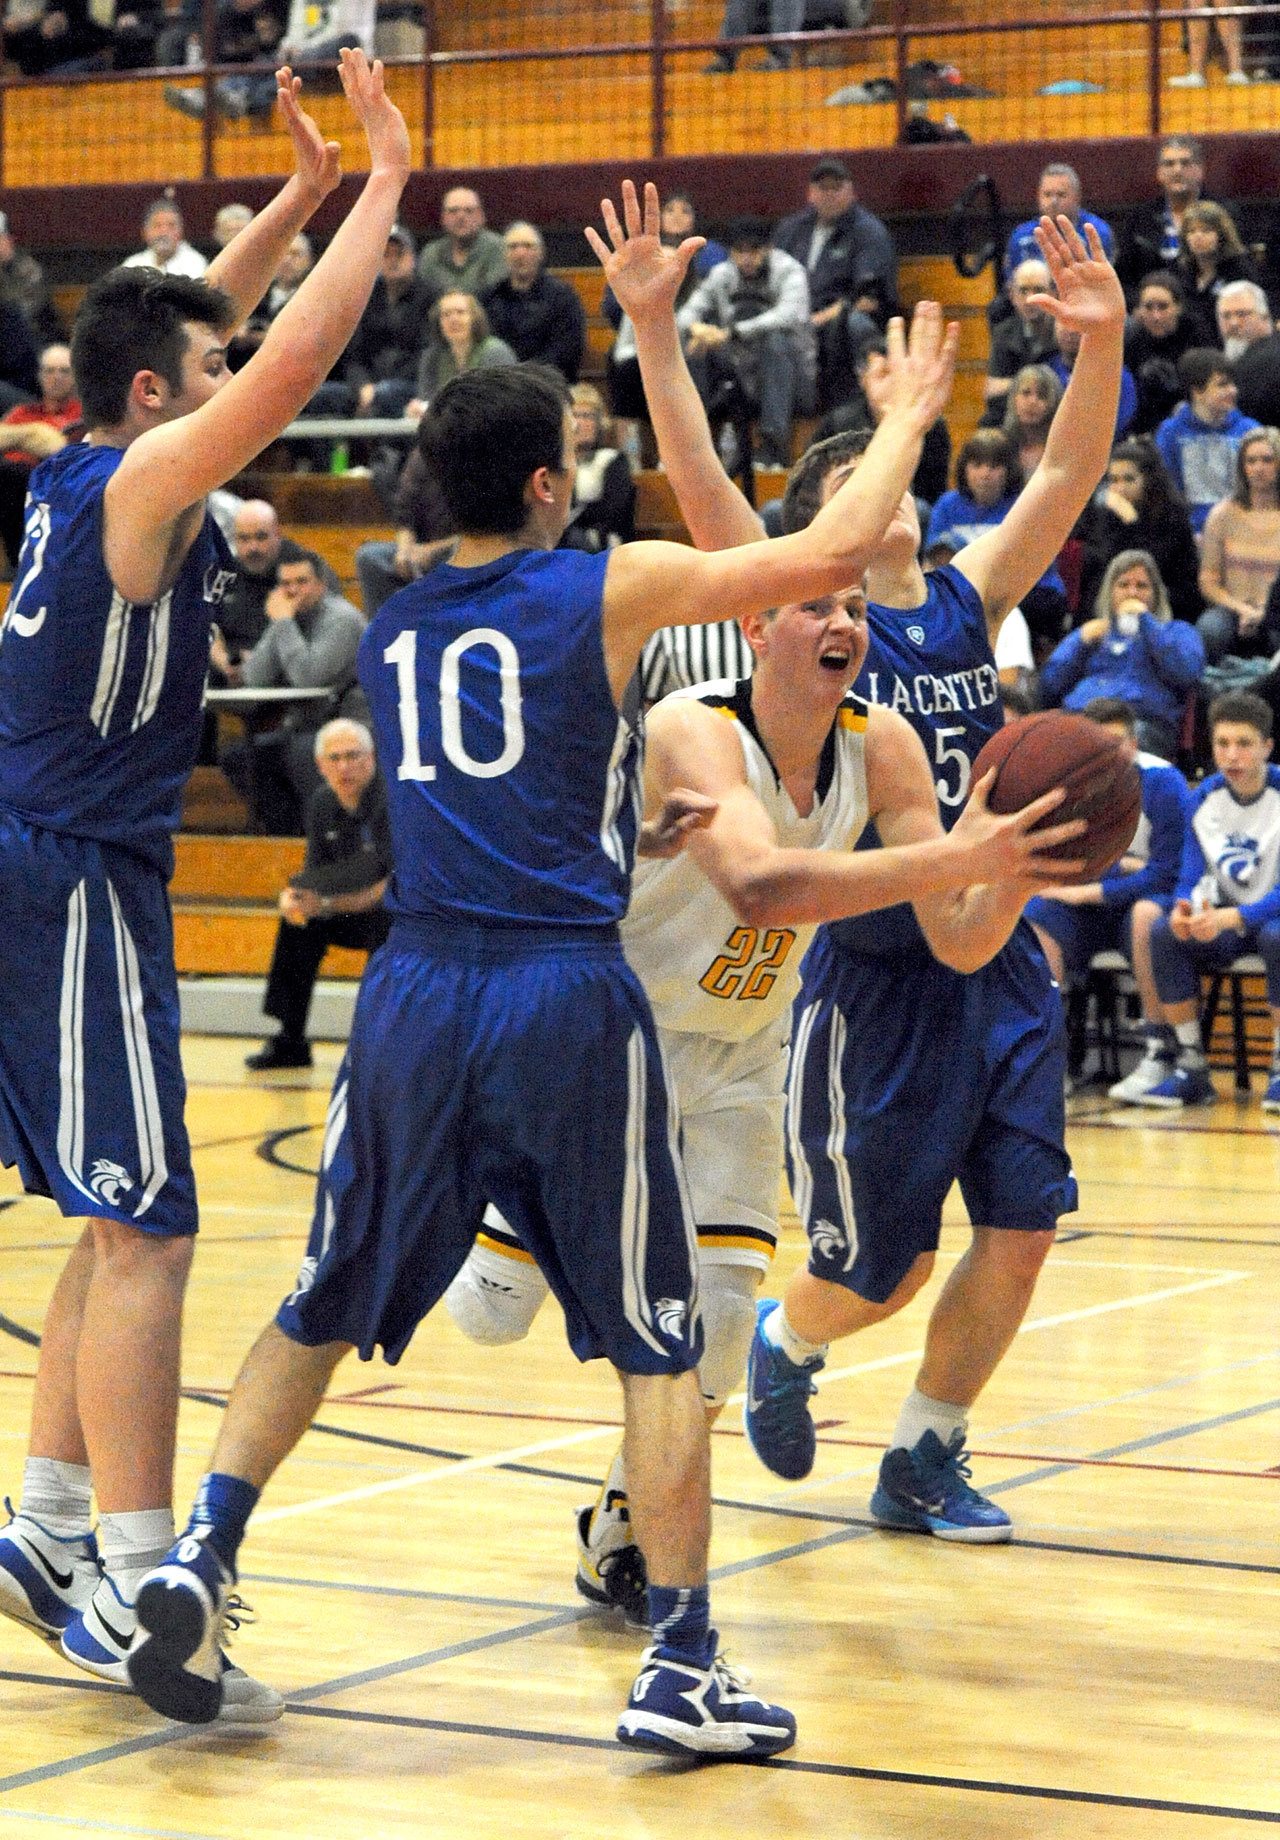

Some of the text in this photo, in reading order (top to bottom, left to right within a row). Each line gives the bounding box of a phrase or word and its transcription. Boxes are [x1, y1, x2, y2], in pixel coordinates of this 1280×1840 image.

[383, 628, 526, 782] 10
[868, 672, 915, 713] LA
[934, 726, 971, 807] 5
[698, 926, 797, 1000] 22
